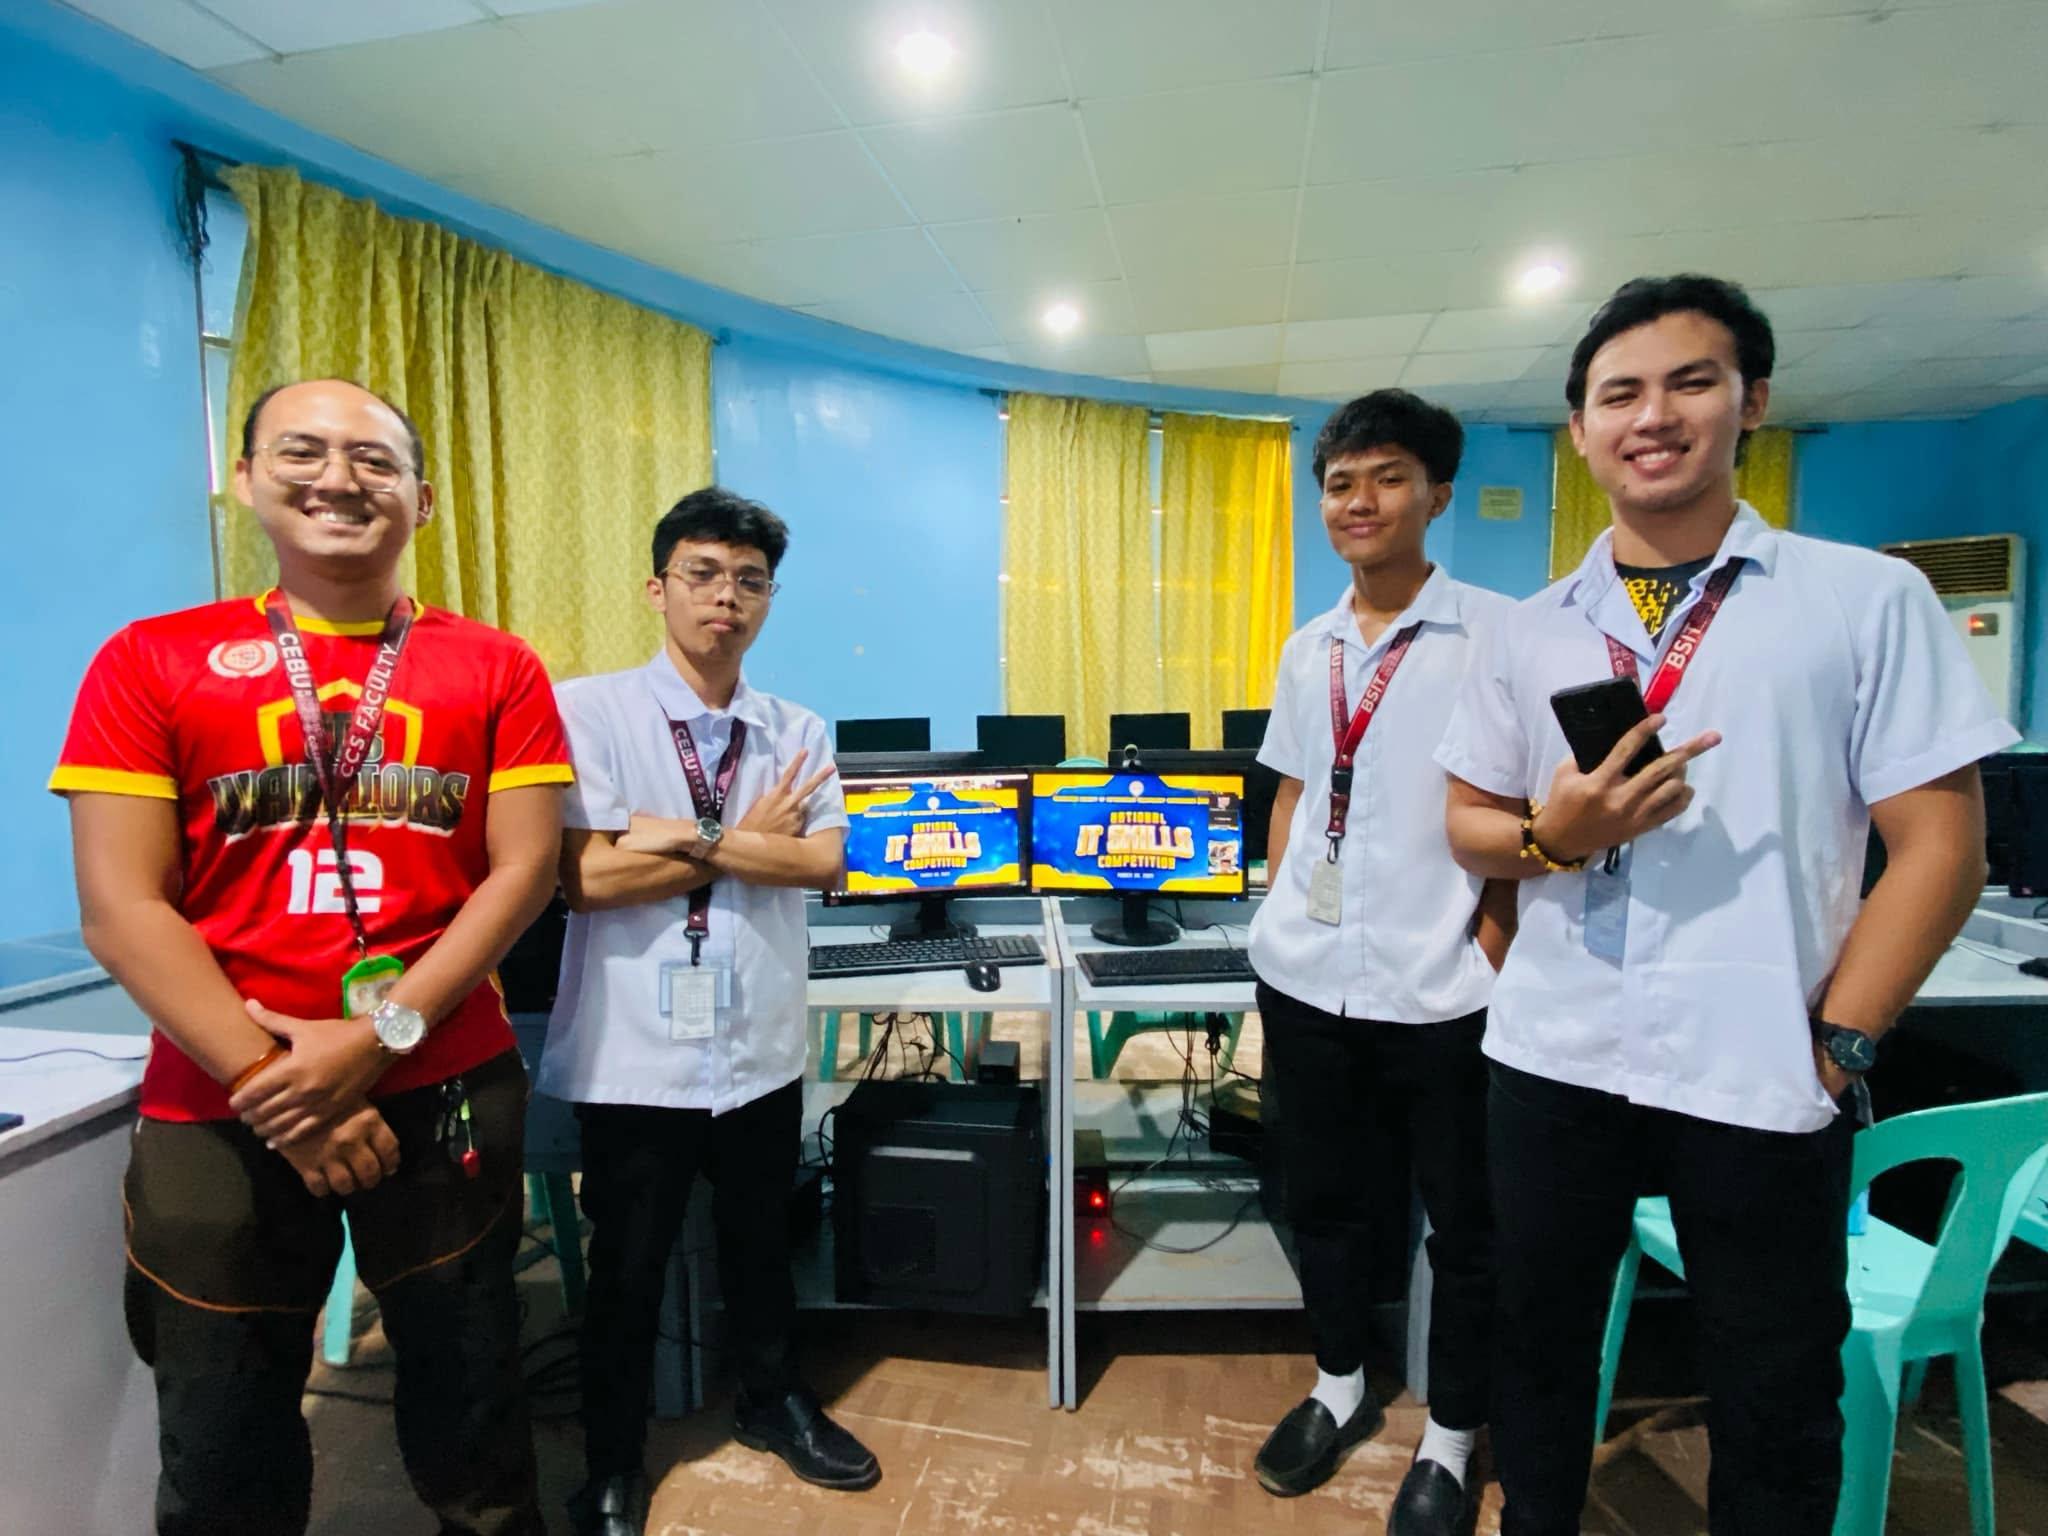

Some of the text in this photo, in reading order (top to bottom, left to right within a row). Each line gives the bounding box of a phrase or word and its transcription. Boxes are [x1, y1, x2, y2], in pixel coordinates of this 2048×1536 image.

[278, 632, 313, 689] CEBU
[1664, 622, 1702, 671] BSIT
[340, 735, 366, 778] CCS
[356, 642, 398, 732] FACULTY
[1359, 675, 1387, 713] BSIT
[674, 728, 698, 771] CEBU
[207, 762, 471, 841] WARIORS
[287, 848, 384, 915] 12
